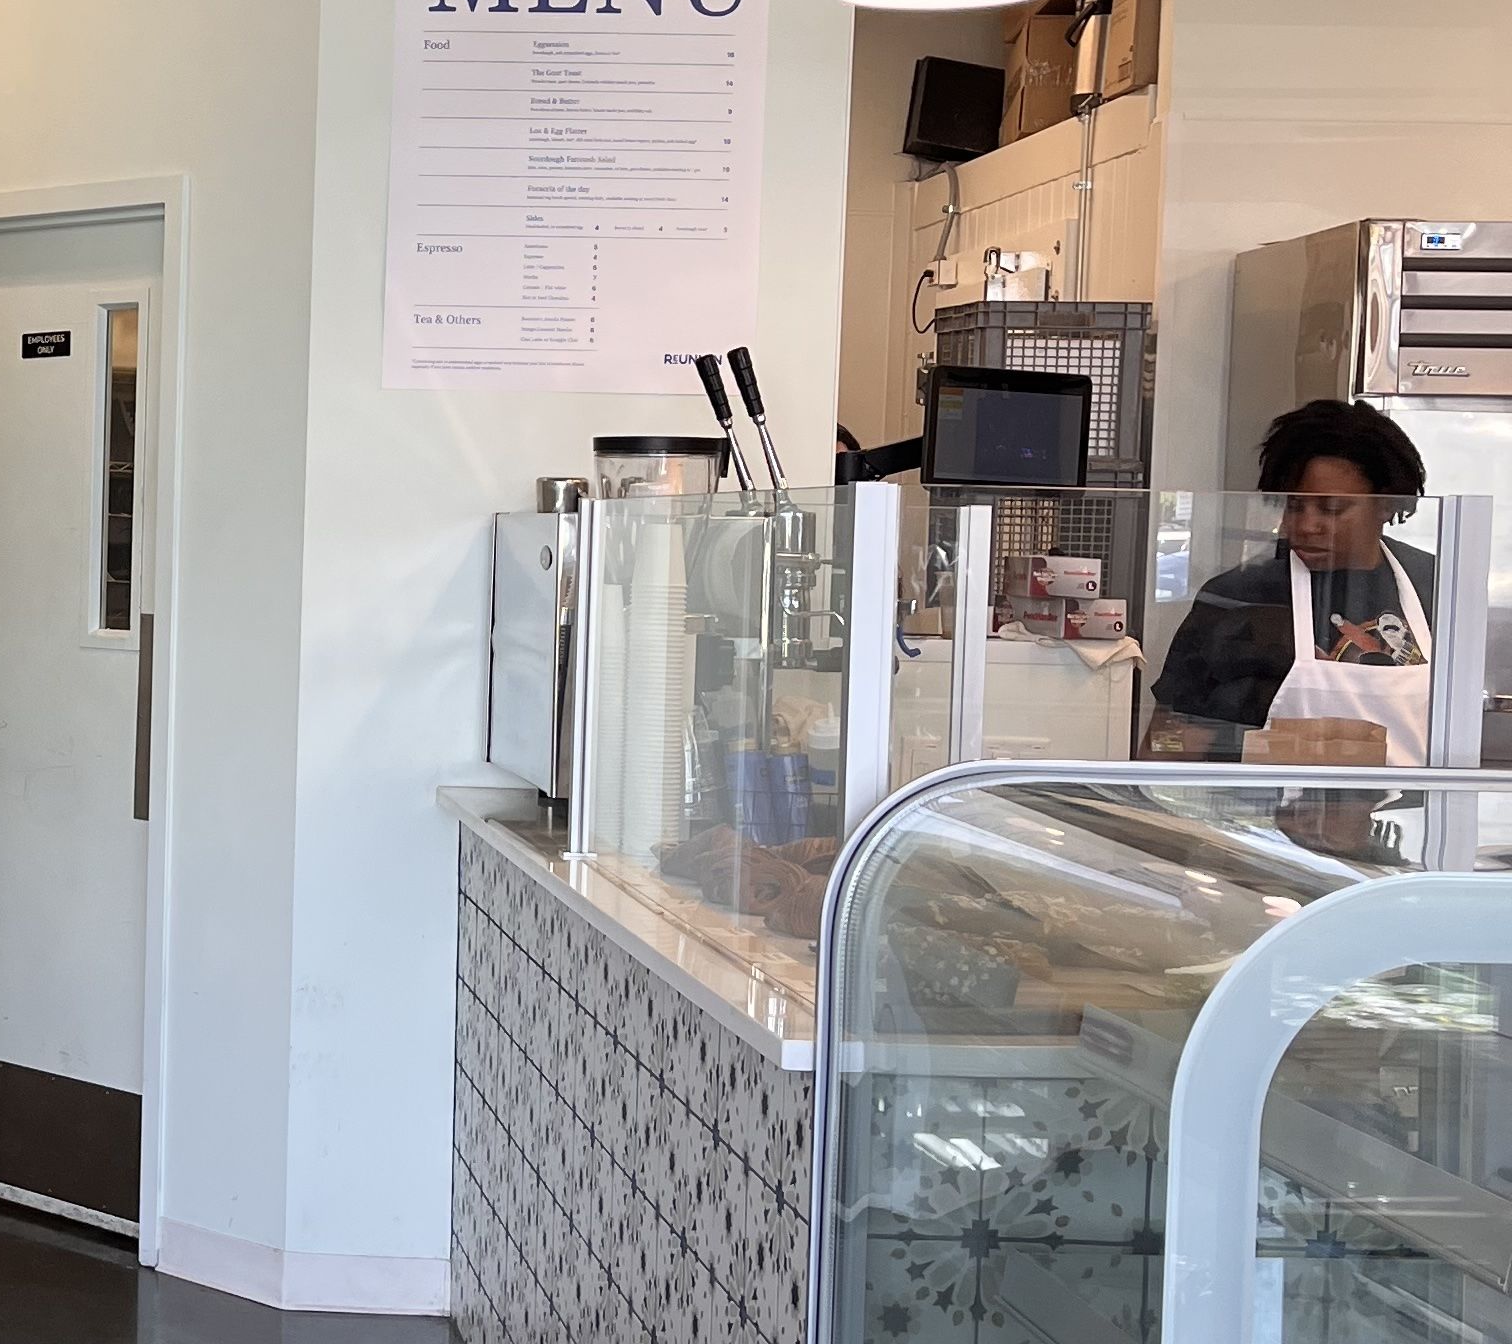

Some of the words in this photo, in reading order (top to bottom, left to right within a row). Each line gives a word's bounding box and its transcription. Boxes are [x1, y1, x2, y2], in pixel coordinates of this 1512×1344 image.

[423, 40, 450, 51] Food
[416, 242, 463, 256] Espresso
[414, 313, 432, 325] Tea
[435, 314, 443, 325] &
[446, 314, 481, 326] Others
[28, 334, 65, 344] EMPLOYEES
[37, 346, 55, 354] ONLY
